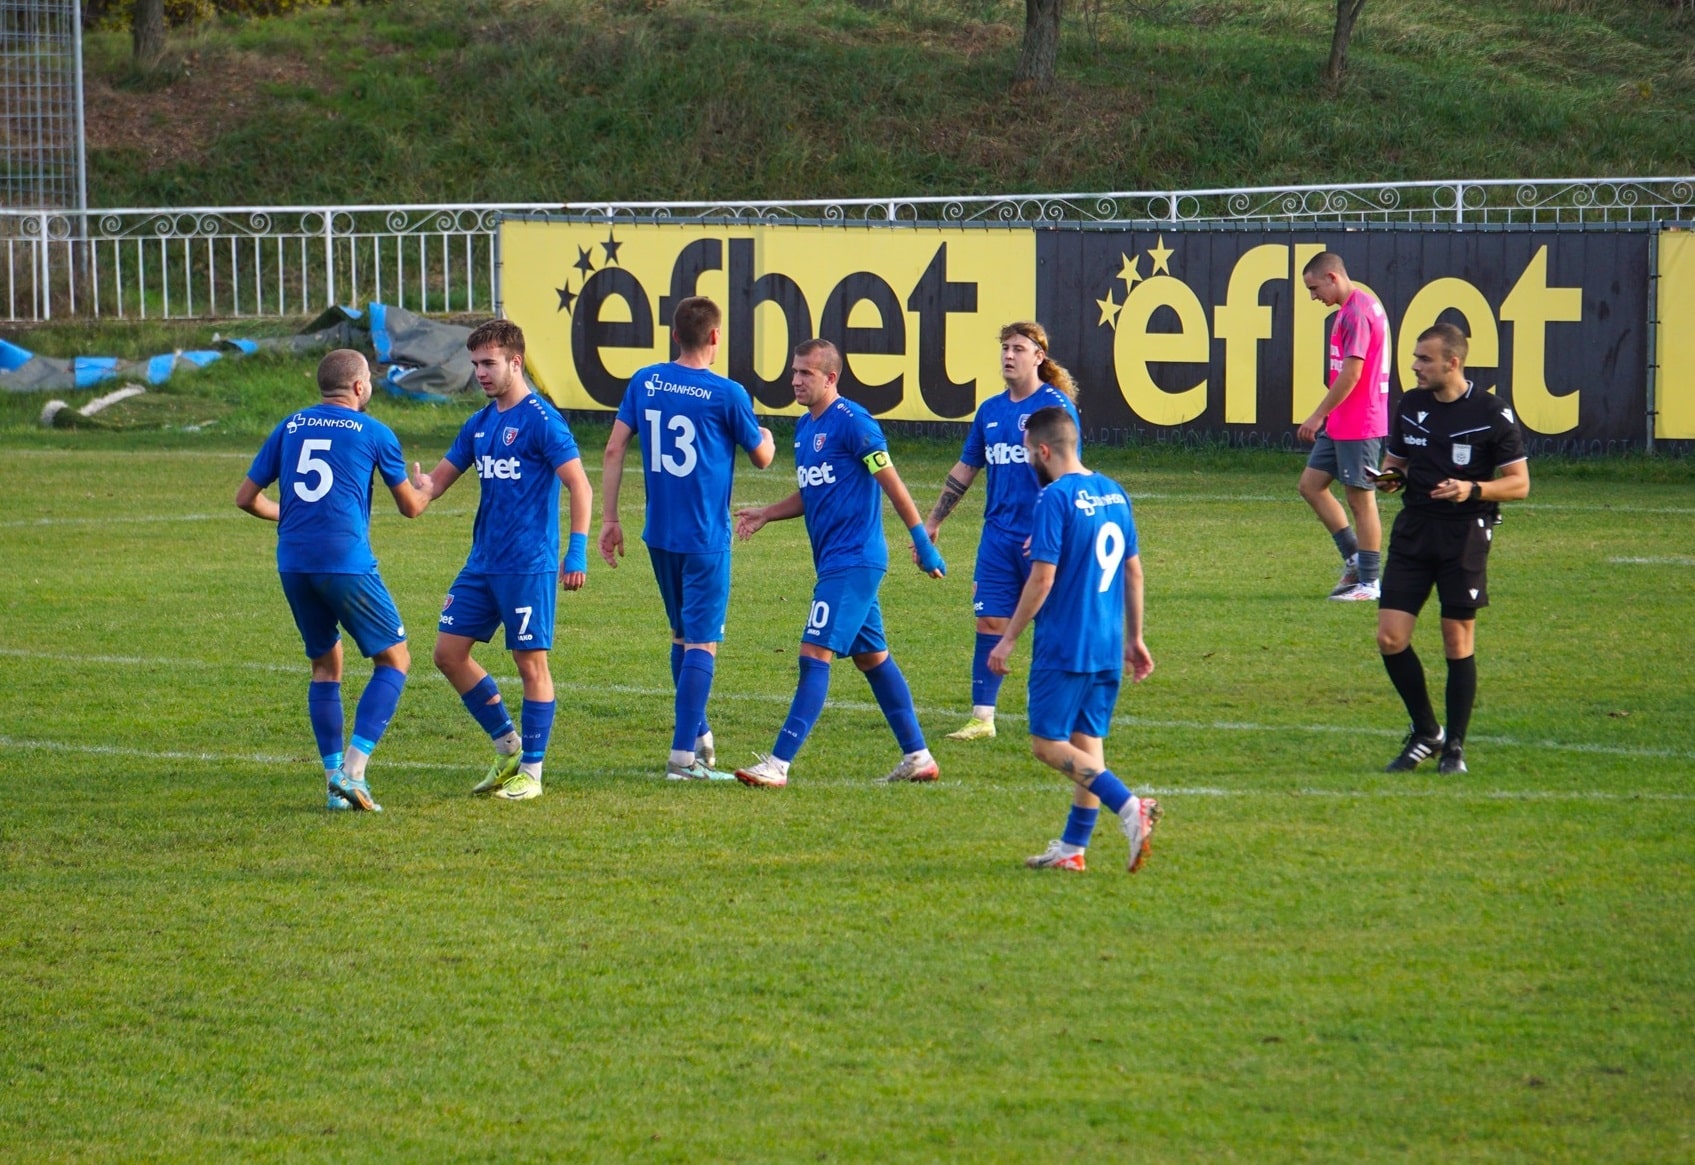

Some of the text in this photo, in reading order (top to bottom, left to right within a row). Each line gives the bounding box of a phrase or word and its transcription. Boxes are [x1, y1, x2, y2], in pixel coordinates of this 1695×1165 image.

[571, 238, 978, 419] efbet
[1113, 243, 1582, 435] efbet
[663, 382, 712, 400] DANHSON
[307, 417, 363, 432] DANHSON
[644, 408, 698, 477] 13
[293, 439, 334, 503] 5
[1095, 521, 1126, 592] 9
[515, 606, 532, 635] 7
[807, 600, 830, 628] 10
